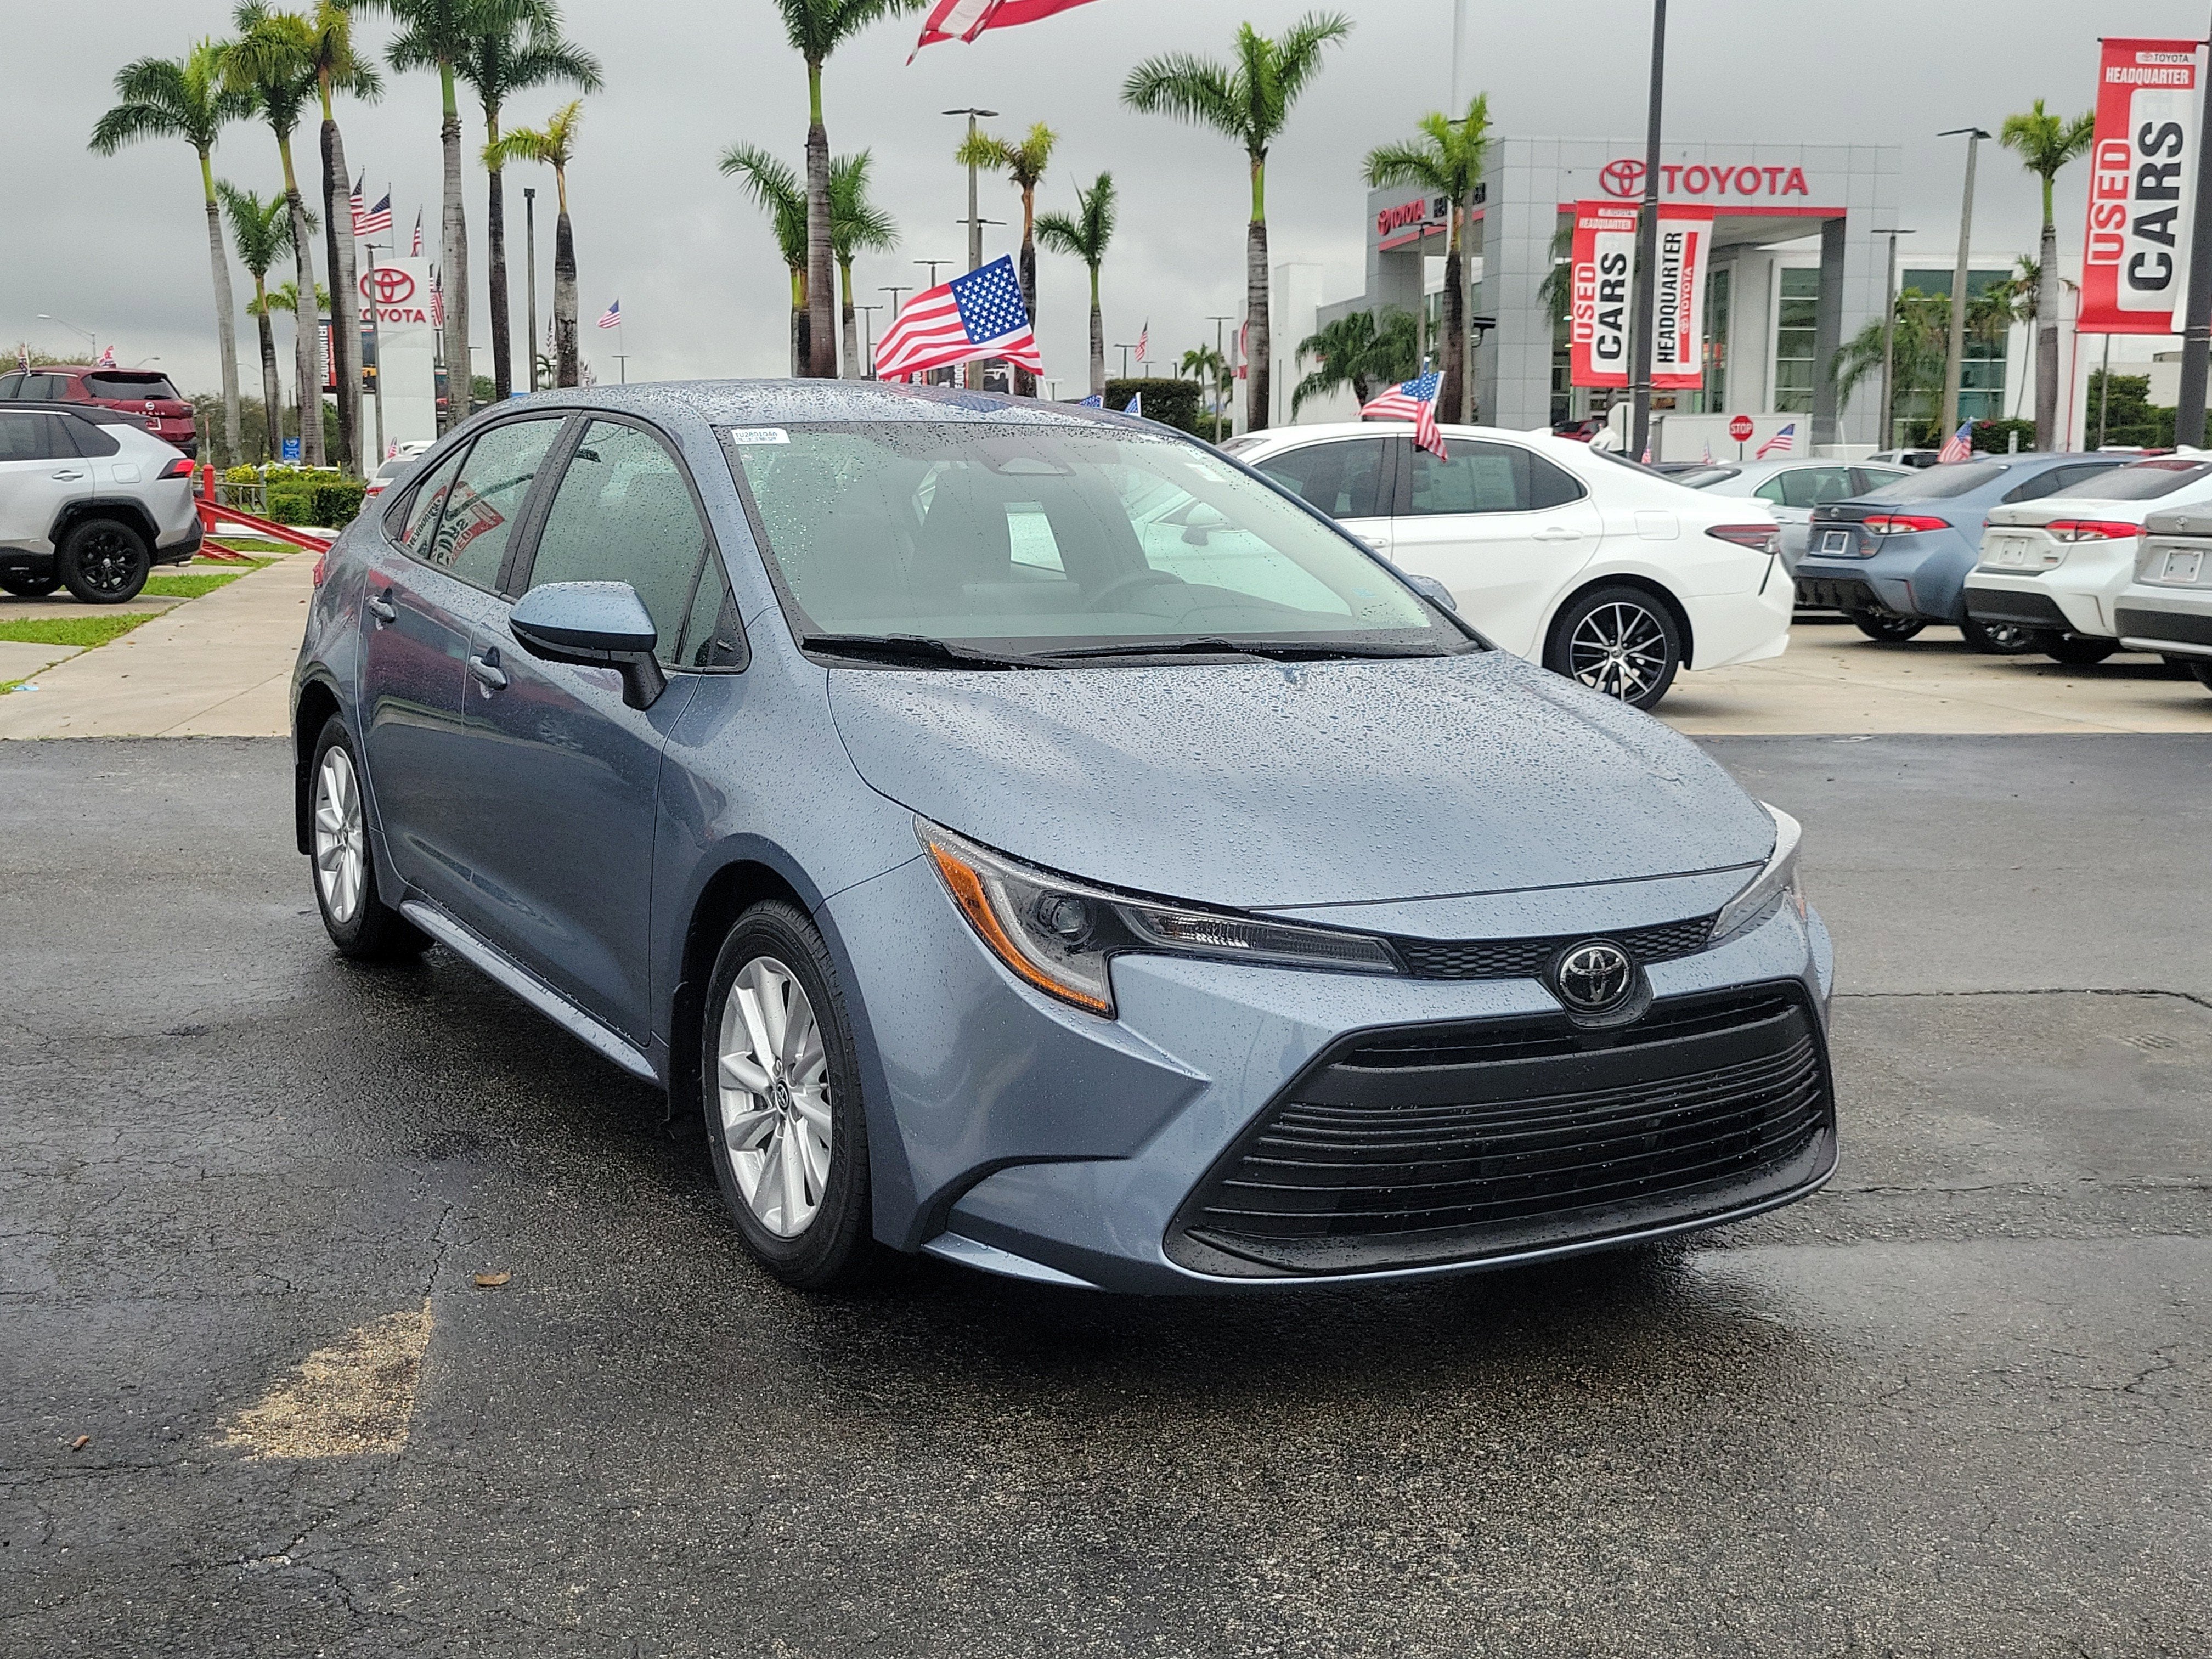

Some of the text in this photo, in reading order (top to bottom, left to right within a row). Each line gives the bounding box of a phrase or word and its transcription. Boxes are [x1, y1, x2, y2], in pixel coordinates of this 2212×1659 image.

[2106, 67, 2189, 85] HEADQUARTER
[2154, 54, 2189, 62] TOYOTA
[1661, 166, 1809, 195] TOYOTA
[2091, 142, 2131, 262] USED
[2128, 122, 2183, 291] CARS
[1575, 265, 1596, 340] USED
[1597, 253, 1627, 360] CARS
[1657, 233, 1683, 363] HEADQUARTER
[1680, 266, 1693, 315] TOYOTA
[1730, 422, 1753, 434] STOP
